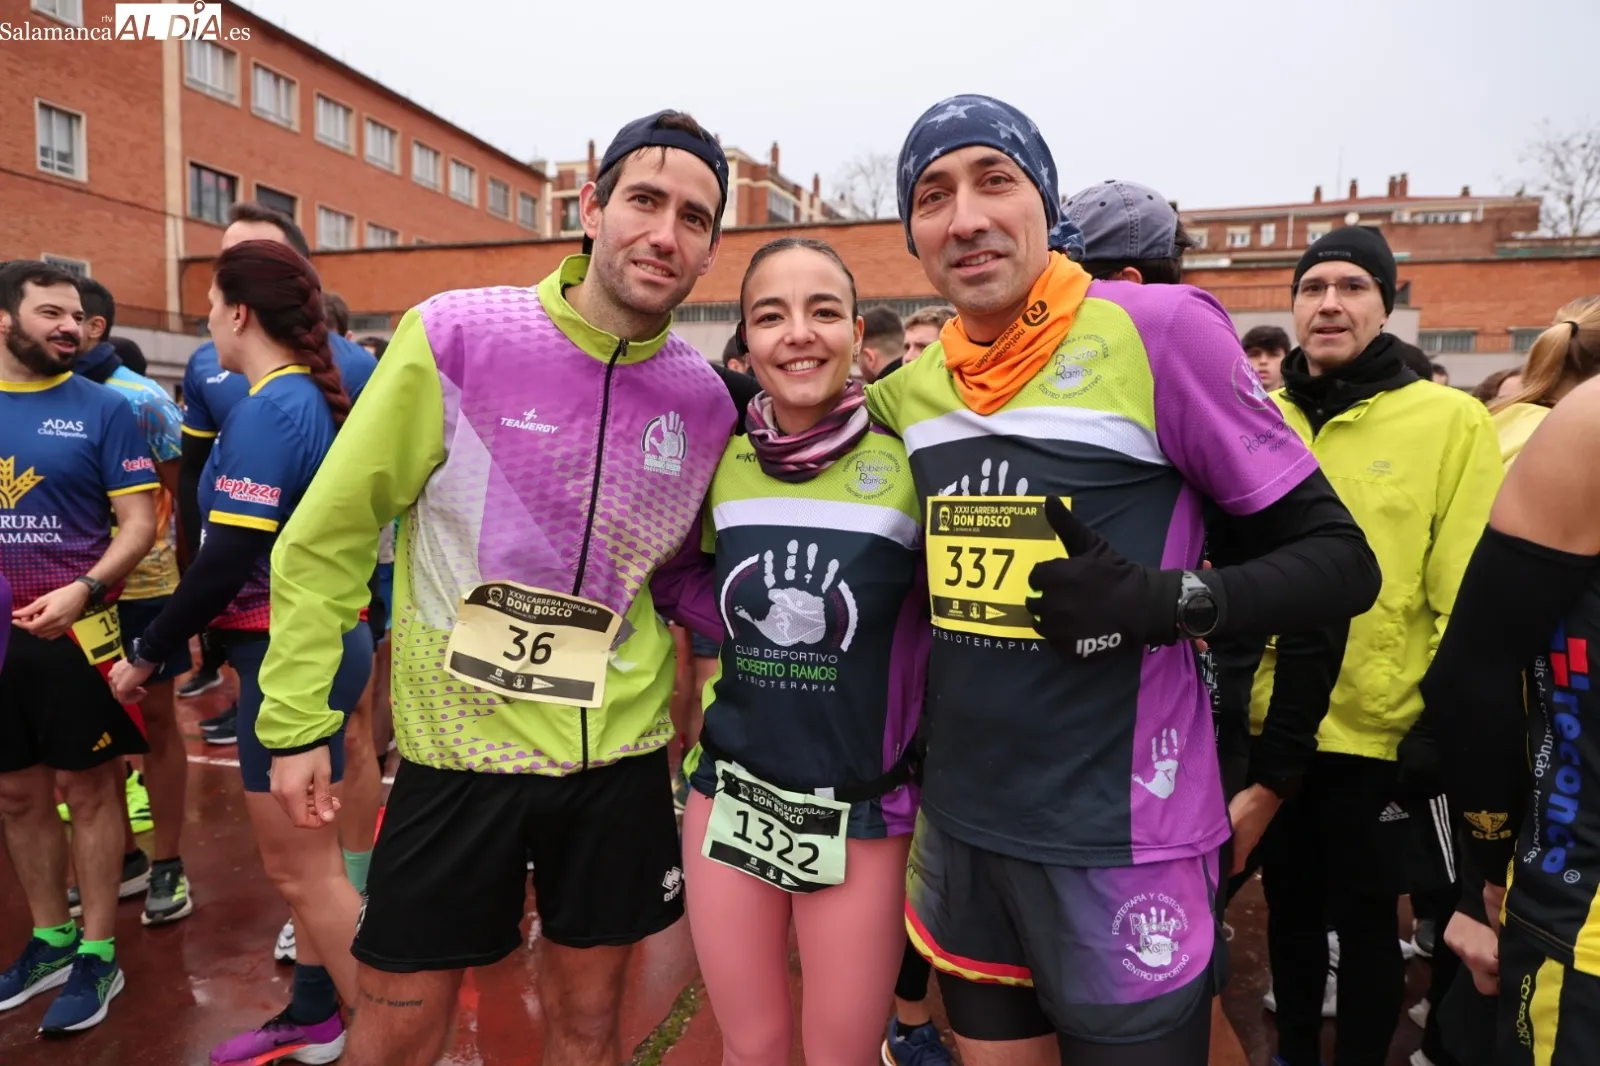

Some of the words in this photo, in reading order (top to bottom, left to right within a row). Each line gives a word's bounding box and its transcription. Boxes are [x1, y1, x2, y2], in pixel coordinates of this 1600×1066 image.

[38, 428, 55, 436] Club
[42, 419, 84, 432] ADAS
[500, 417, 559, 434] TEAMERGY
[953, 515, 974, 526] DON
[976, 516, 1011, 527] BOSCO
[954, 505, 969, 514] XXXI
[970, 506, 998, 516] CARRERA
[1000, 506, 1037, 516] POPULAR
[0, 515, 62, 529] RURAL
[945, 546, 1015, 590] 337
[506, 597, 531, 613] DON
[533, 604, 573, 618] BOSCO
[509, 589, 526, 600] XXXI
[526, 595, 561, 607] CARRERA
[562, 601, 598, 615] POPULAR
[502, 624, 556, 665] 36
[735, 644, 760, 657] CLUB
[763, 648, 838, 664] DEPORTIVO
[736, 657, 786, 677] ROBERTO
[789, 663, 838, 681] RAMOS
[738, 673, 836, 692] FISIOTERAPIA
[752, 794, 773, 809] DON
[773, 803, 804, 825] BOSCO
[767, 793, 793, 812] CARRERA
[793, 806, 827, 815] POPULAR
[733, 810, 820, 876] 1322
[1112, 893, 1147, 935] FISIOTERAPIA
[1122, 958, 1152, 981] CENTRO
[1154, 954, 1189, 981] DEPORTIVO
